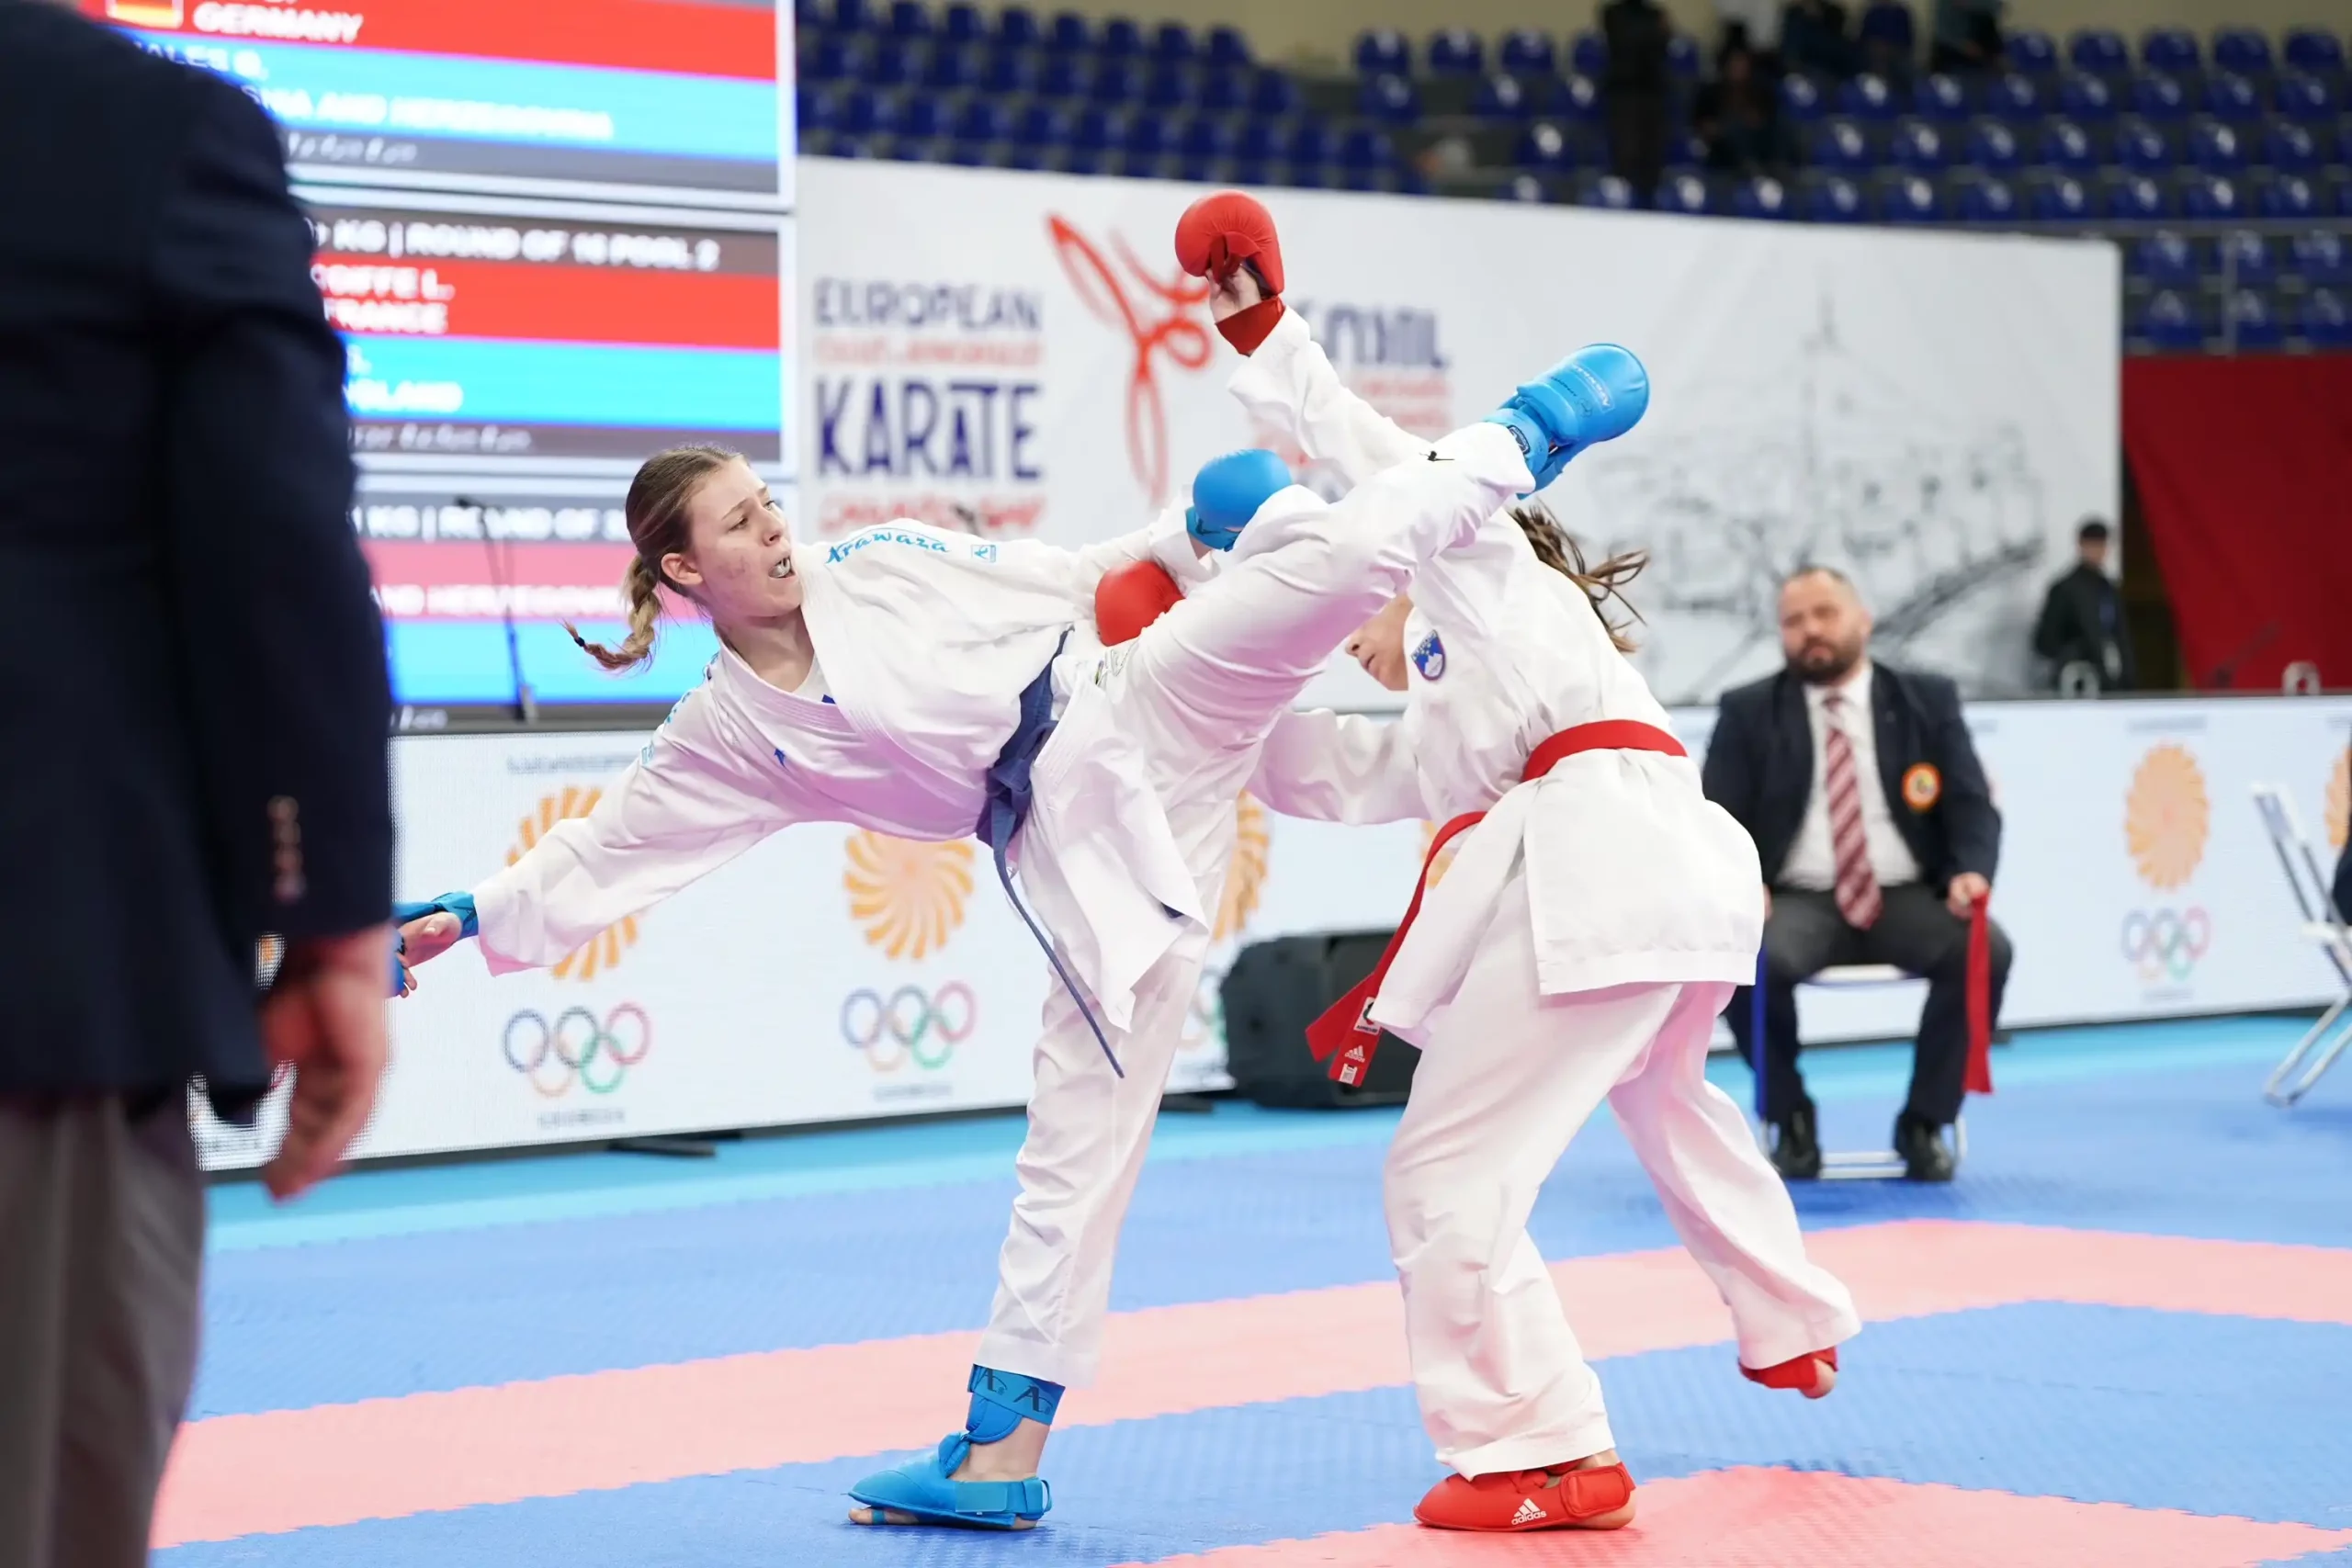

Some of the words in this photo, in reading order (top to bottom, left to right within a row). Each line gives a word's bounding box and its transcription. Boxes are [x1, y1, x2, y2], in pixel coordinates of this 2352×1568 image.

[192, 3, 364, 42] GERMANY
[317, 92, 388, 125] AND
[334, 219, 387, 253] KG
[404, 224, 521, 261] ROUND
[521, 228, 569, 262] OF
[609, 233, 694, 270] POOL
[322, 296, 449, 334] FRANCE
[812, 276, 1045, 333] EUROPEAN
[342, 378, 465, 413] NGLAND
[815, 375, 1046, 483] KARATE
[1511, 1509, 1548, 1527] adidas
